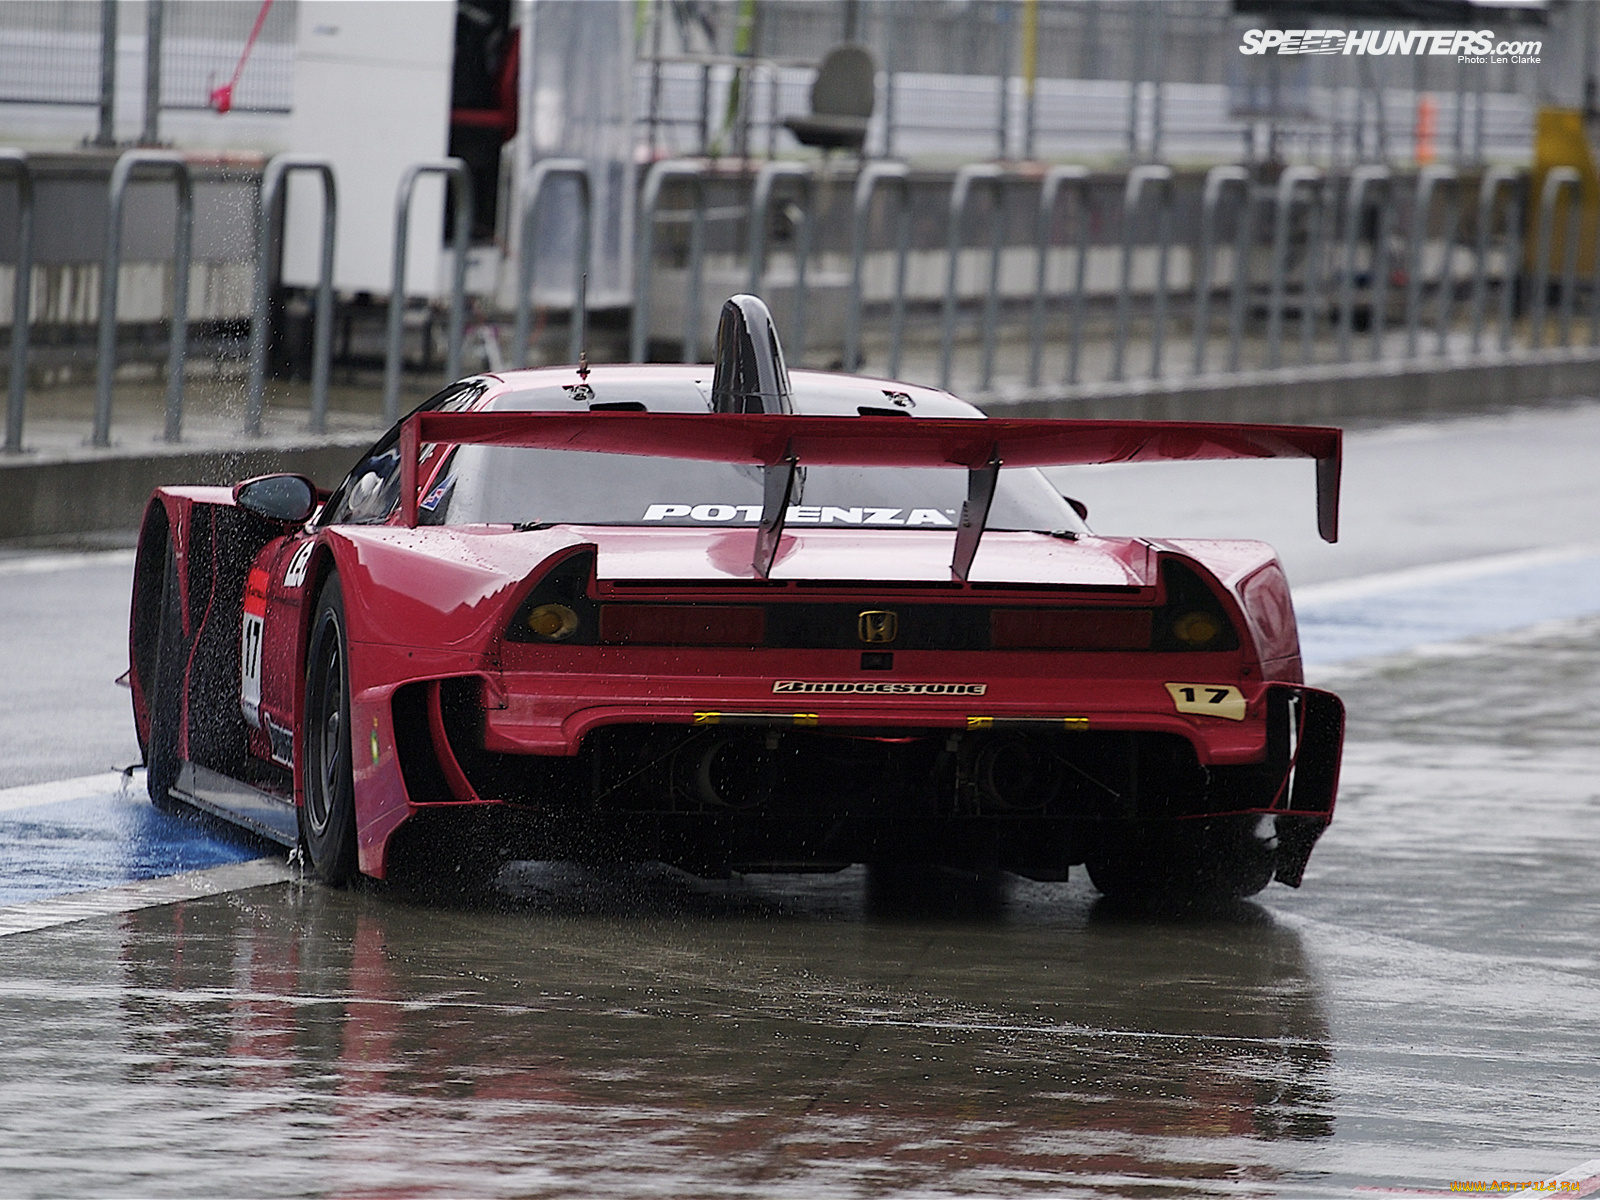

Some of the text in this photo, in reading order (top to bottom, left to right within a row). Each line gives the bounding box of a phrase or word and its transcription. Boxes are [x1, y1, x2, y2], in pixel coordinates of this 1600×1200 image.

[643, 504, 953, 525] POTENZA
[773, 681, 987, 695] BRIDGESTONE
[1179, 688, 1229, 704] 17
